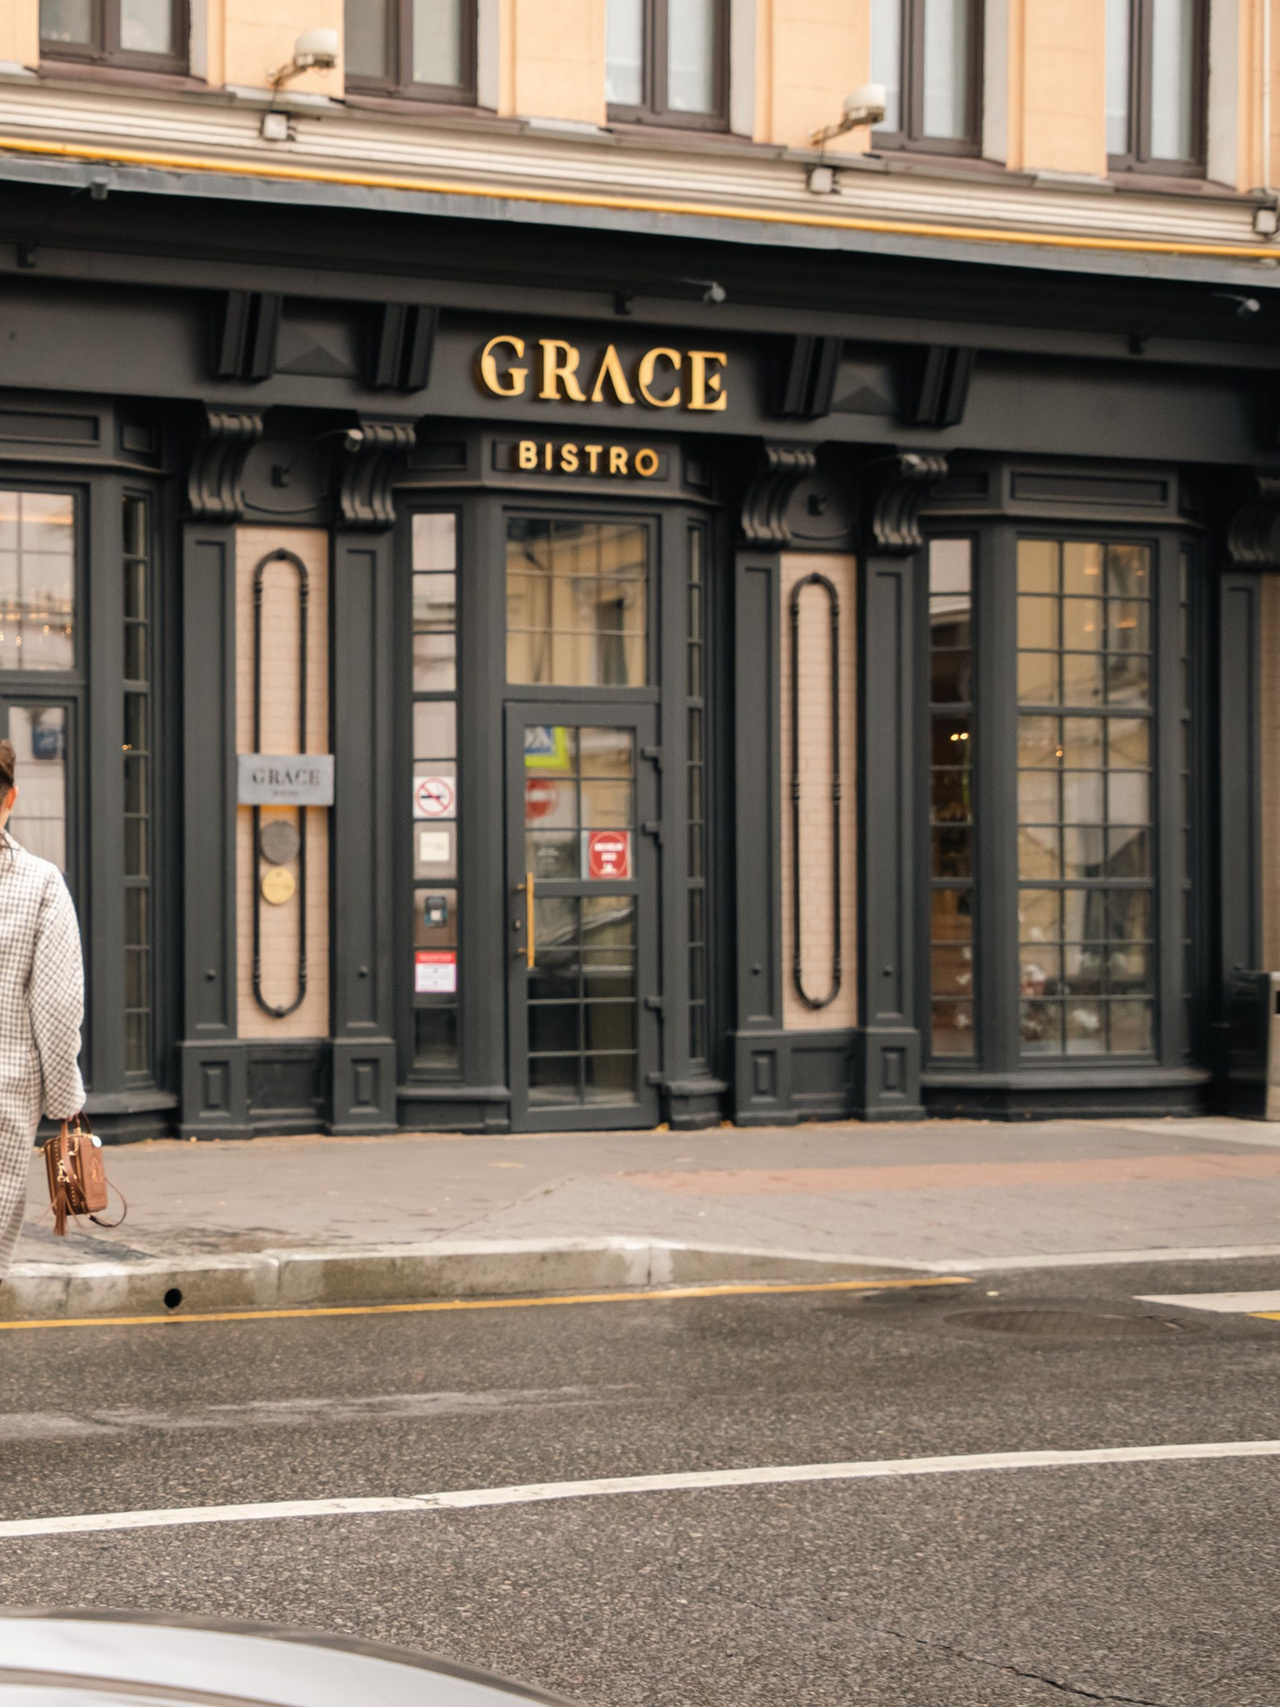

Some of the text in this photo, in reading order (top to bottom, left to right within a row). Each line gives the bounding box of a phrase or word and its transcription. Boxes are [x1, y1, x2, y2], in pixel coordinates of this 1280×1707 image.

[481, 335, 728, 411] GRACE
[519, 440, 659, 477] BISTRO
[251, 767, 321, 786] GRACE
